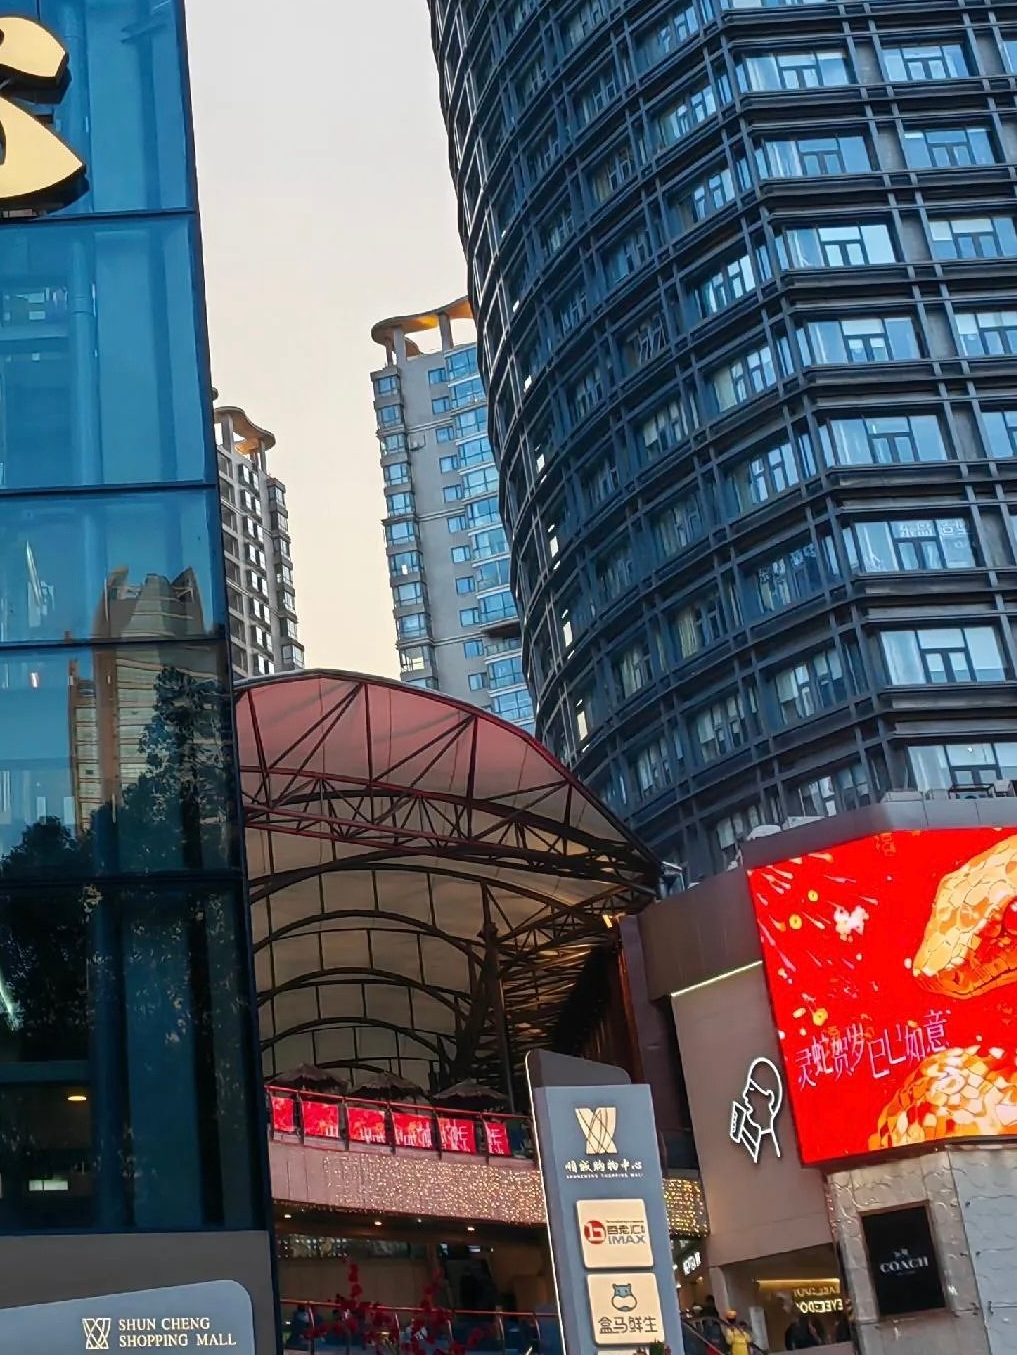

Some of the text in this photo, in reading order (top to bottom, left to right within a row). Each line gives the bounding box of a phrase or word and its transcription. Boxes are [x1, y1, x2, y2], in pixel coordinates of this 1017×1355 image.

[607, 1235, 647, 1245] IMAX
[879, 1255, 929, 1273] COACH
[119, 1317, 210, 1331] SHUN CHENG
[598, 1316, 658, 1335] 盒马鲜生
[119, 1333, 237, 1348] SHOPPING MALL
